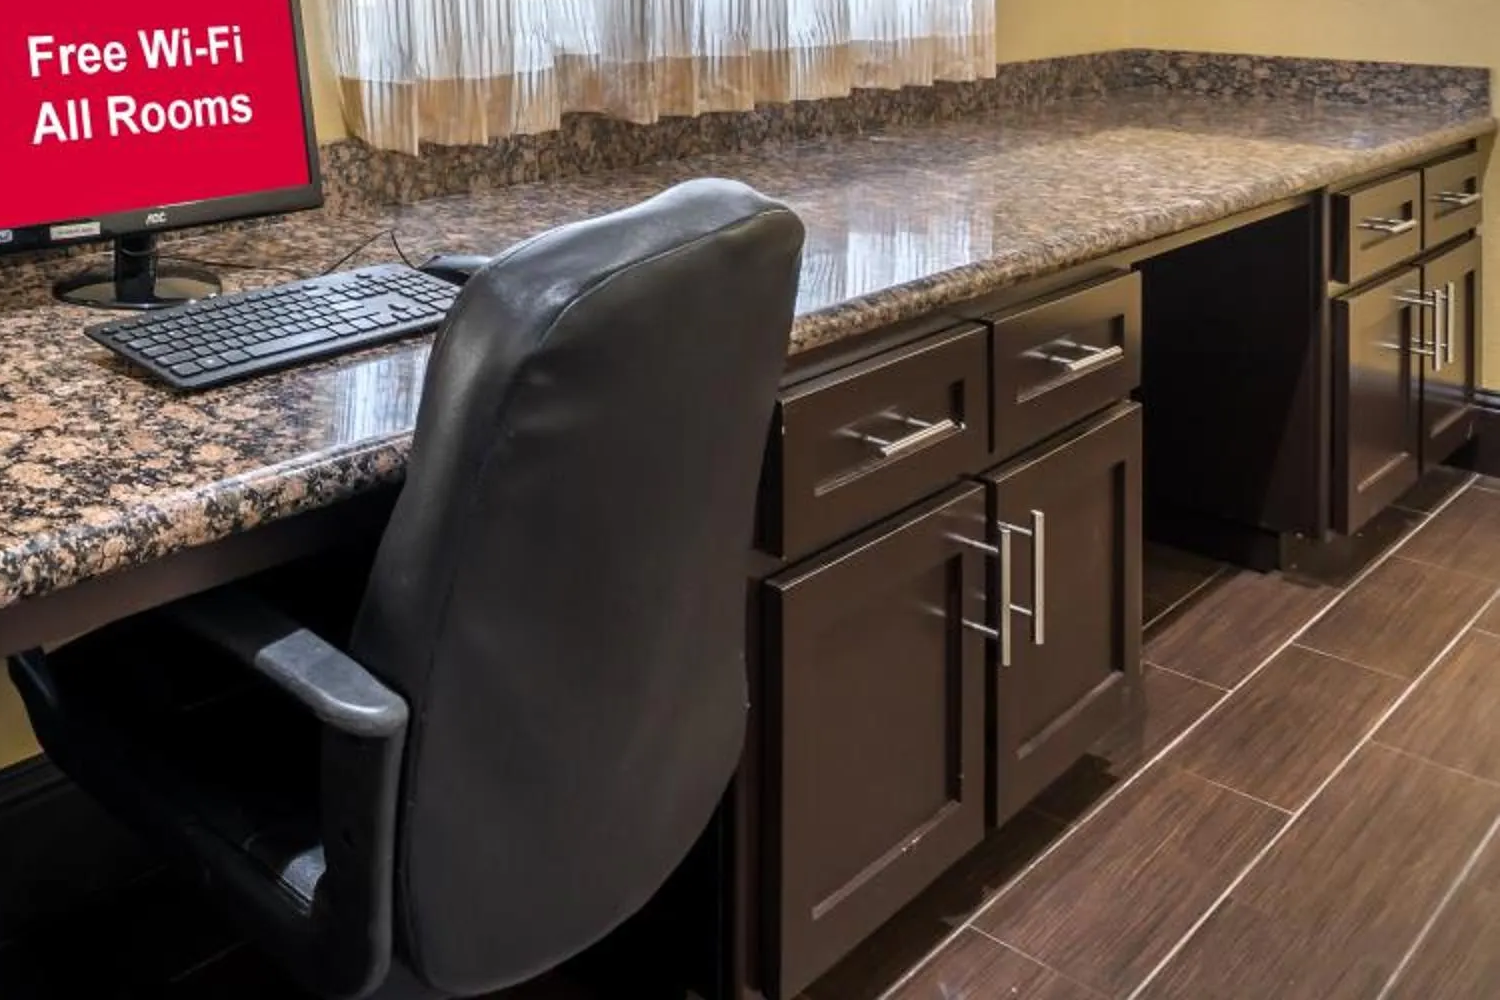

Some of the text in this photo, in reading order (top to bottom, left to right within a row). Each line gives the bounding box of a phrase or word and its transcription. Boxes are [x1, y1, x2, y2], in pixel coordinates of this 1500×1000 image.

[27, 25, 243, 77] Free Wi-Fi
[33, 93, 253, 145] All Rooms
